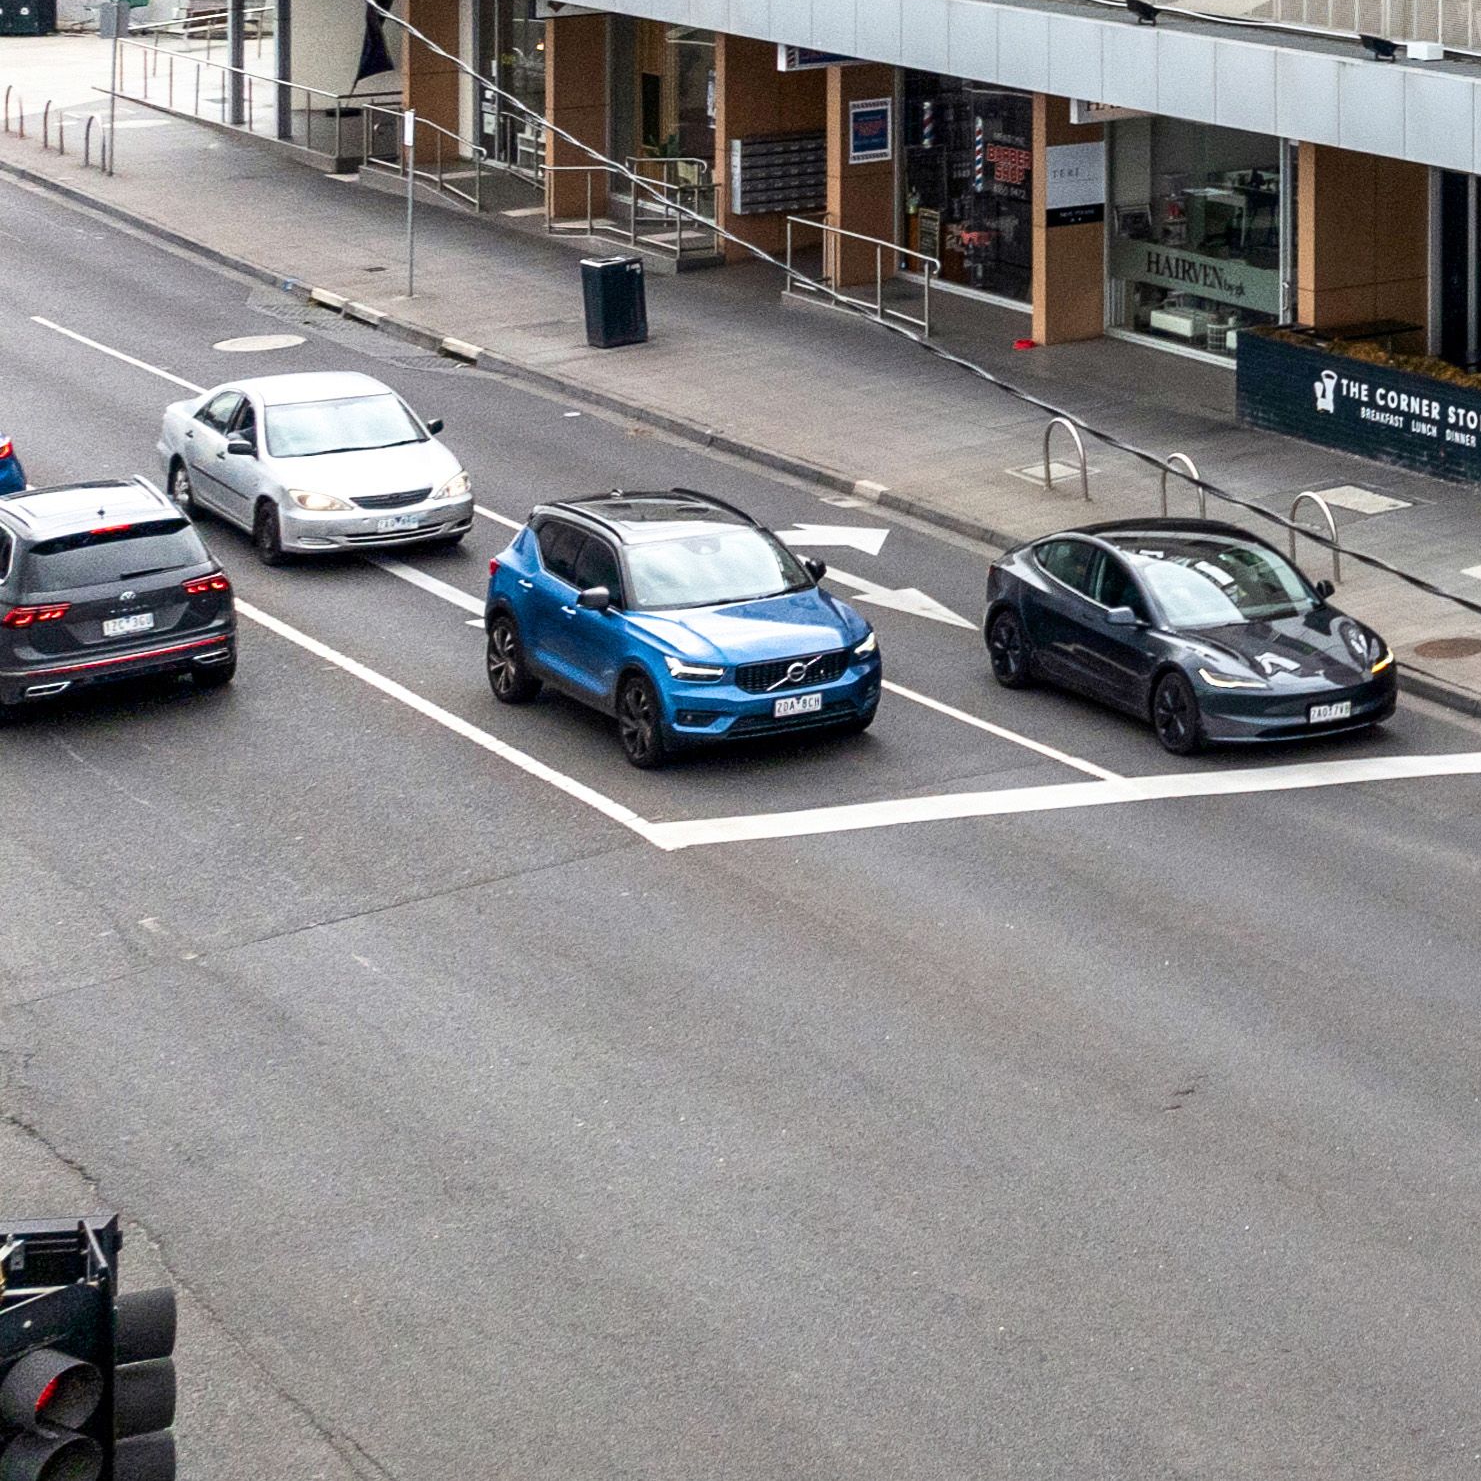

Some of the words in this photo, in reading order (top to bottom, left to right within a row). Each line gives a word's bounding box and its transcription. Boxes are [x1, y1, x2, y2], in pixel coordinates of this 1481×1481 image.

[987, 143, 1031, 169] BARBER
[994, 162, 1025, 184] SHOP
[1146, 251, 1224, 290] HAIRVEN
[1341, 378, 1369, 401] THE
[1376, 388, 1441, 420] CORNER
[1360, 407, 1404, 429] BREAKFAST
[1411, 420, 1438, 438] LUNCH
[1445, 429, 1477, 448] DINNER
